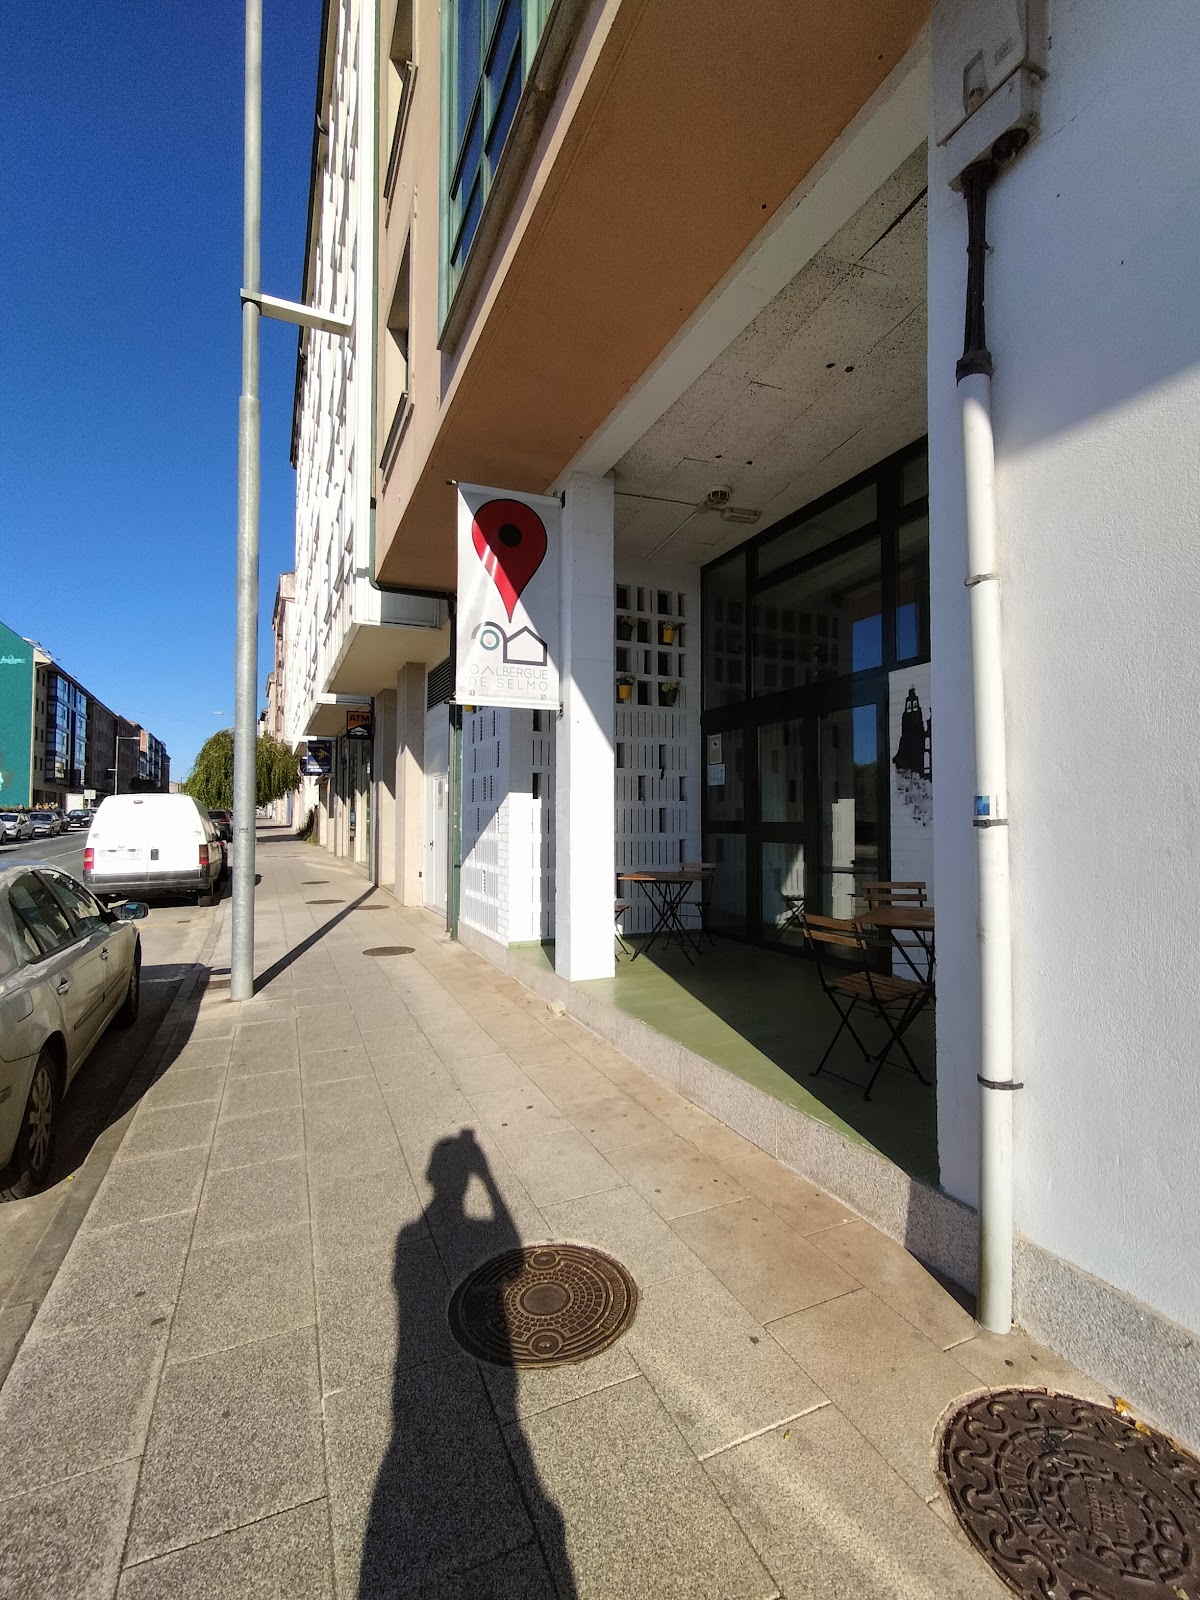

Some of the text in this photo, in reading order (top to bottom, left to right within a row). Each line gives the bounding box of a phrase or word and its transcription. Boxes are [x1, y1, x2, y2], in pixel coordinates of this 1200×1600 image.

[468, 676, 549, 692] DE SELMO
[349, 714, 370, 723] ATM
